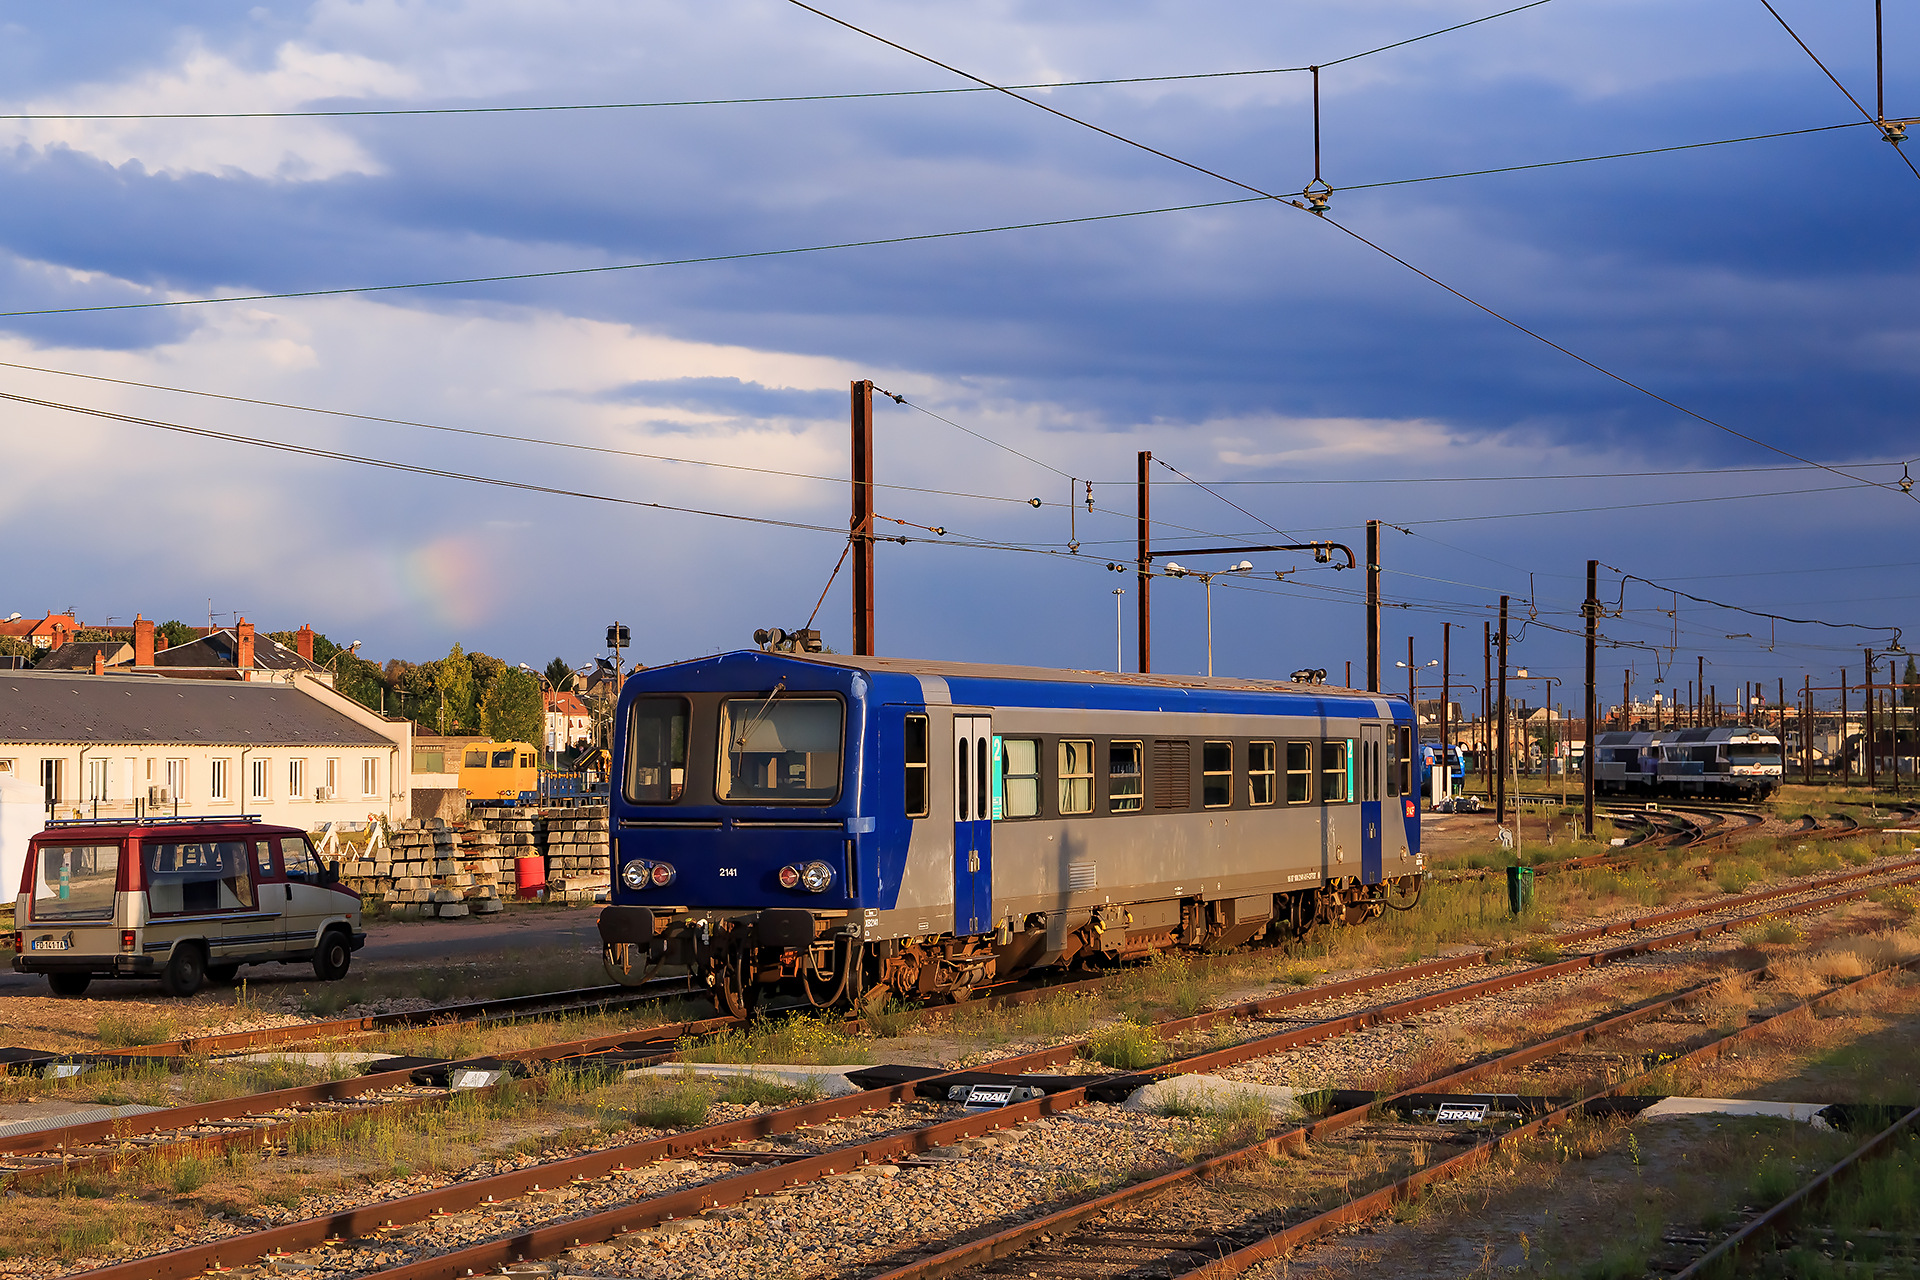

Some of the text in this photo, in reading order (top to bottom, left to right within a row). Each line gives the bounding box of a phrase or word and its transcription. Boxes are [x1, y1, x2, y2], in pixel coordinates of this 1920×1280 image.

[994, 738, 1001, 761] 2
[1347, 741, 1353, 758] 2
[719, 867, 737, 877] 2141
[970, 1092, 1009, 1102] STRAIL
[1439, 1110, 1483, 1120] STRAIL
